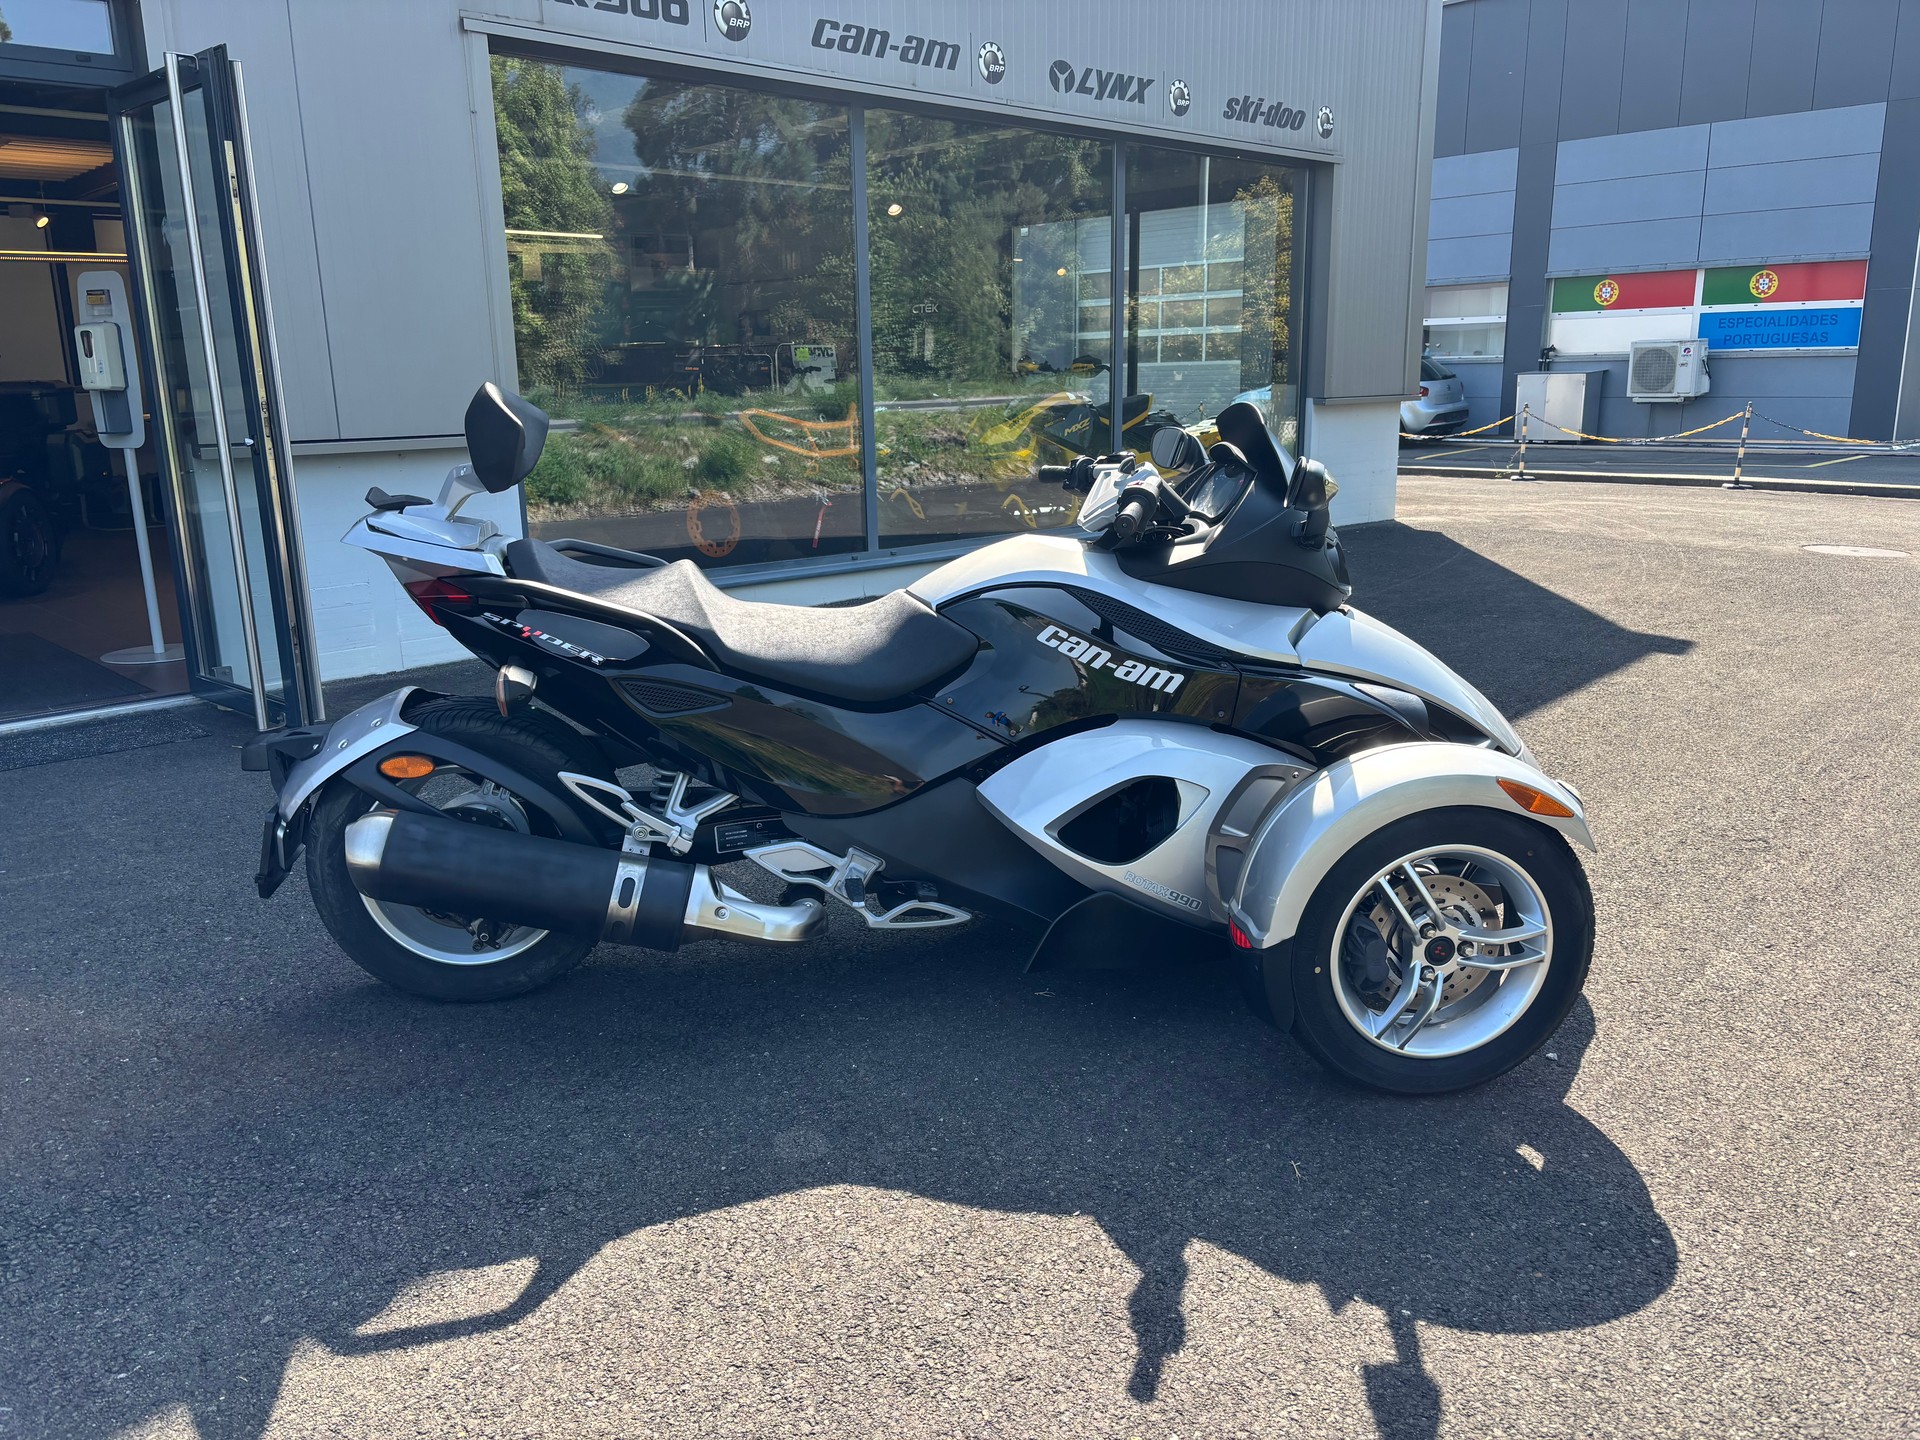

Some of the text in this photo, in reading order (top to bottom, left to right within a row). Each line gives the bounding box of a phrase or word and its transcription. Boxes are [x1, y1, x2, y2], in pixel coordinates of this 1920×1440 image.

[729, 17, 750, 29] BRP
[811, 18, 961, 71] can-am
[988, 64, 1005, 73] BRP
[1074, 67, 1156, 105] LYNX
[1176, 98, 1190, 107] BRP
[1222, 95, 1307, 132] ski-doo
[912, 303, 939, 314] CTEK
[1718, 314, 1839, 329] ESPECIALIDADES
[1723, 332, 1829, 346] PORTUGUESAS
[1036, 624, 1185, 694] can-am
